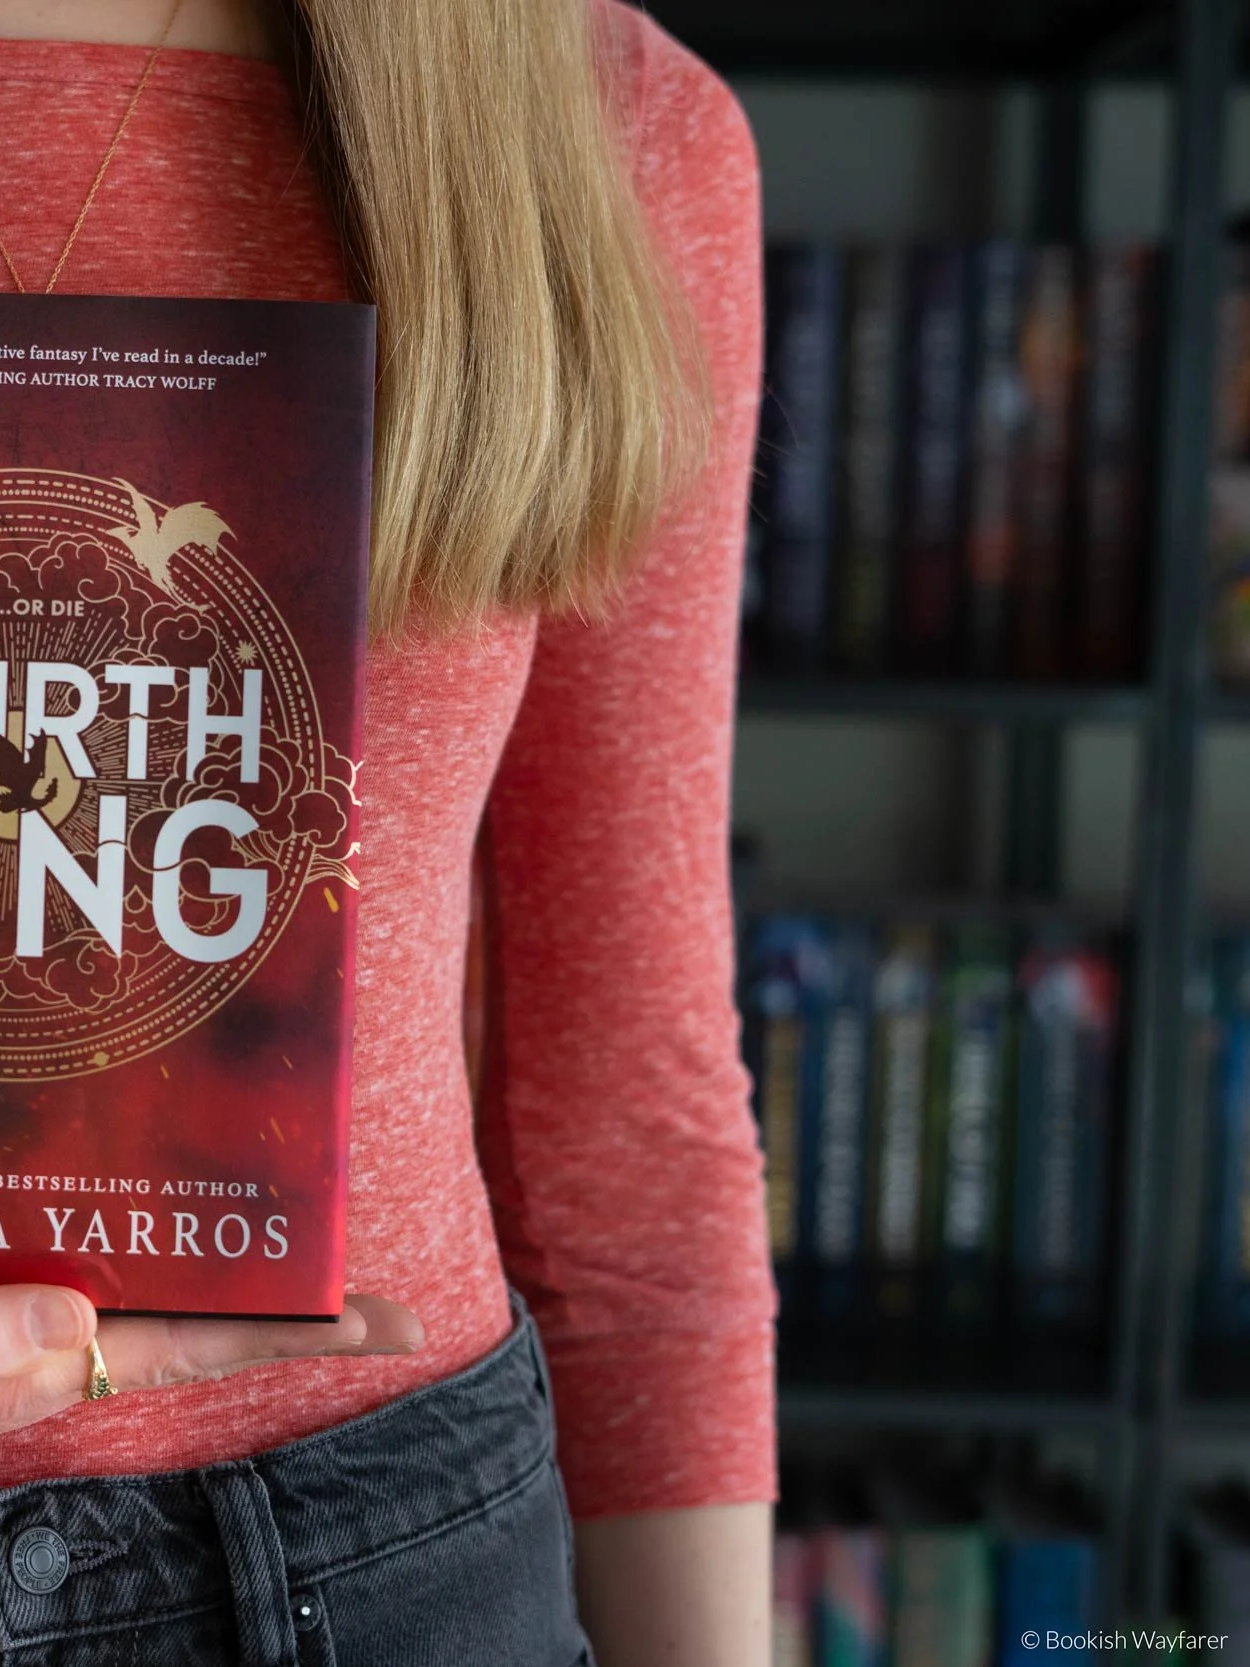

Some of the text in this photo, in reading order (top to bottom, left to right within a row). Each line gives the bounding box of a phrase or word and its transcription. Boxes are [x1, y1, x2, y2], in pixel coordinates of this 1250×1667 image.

[30, 345, 87, 365] fantasy
[92, 347, 120, 362] I’ve
[124, 348, 159, 363] read
[164, 349, 180, 364] in
[185, 354, 194, 364] a
[198, 350, 267, 366] decade!”
[30, 373, 100, 387] AUTHOR
[103, 375, 156, 388] TRACY
[160, 376, 217, 391] WOLFF
[51, 600, 85, 617] DIE
[160, 1180, 259, 1198] AUTHOR
[42, 1207, 288, 1259] YARROS
